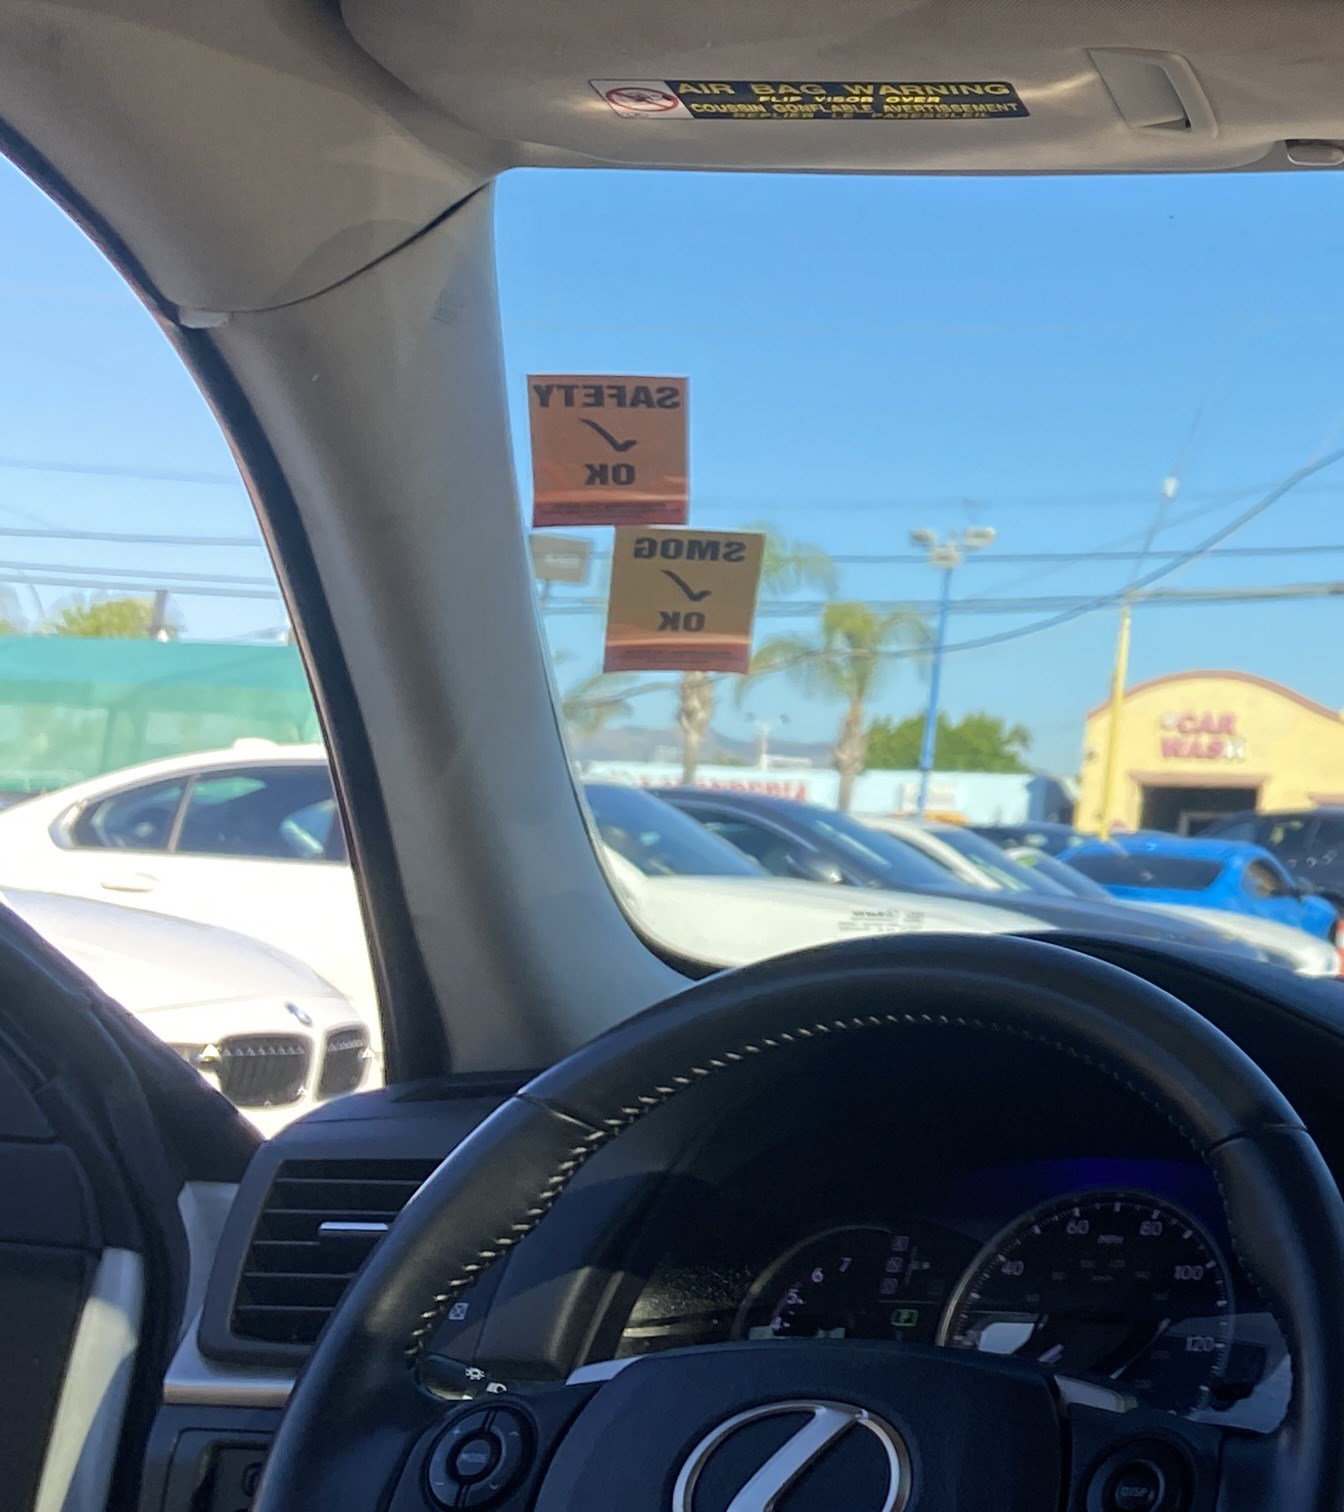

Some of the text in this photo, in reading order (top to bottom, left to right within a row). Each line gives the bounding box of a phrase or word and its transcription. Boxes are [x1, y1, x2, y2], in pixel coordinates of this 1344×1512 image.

[678, 82, 1010, 96] AIR BAG WARNING
[885, 95, 941, 103] OVER
[690, 103, 767, 113] COUSSIN
[882, 103, 1019, 113] AVERTISSEMENT
[1065, 1219, 1090, 1236] 60
[1138, 1219, 1164, 1237] 80
[838, 1257, 854, 1274] 7
[1000, 1259, 1026, 1277] 40
[1173, 1264, 1205, 1281] 100
[811, 1266, 825, 1284] 6
[1185, 1335, 1217, 1353] 120
